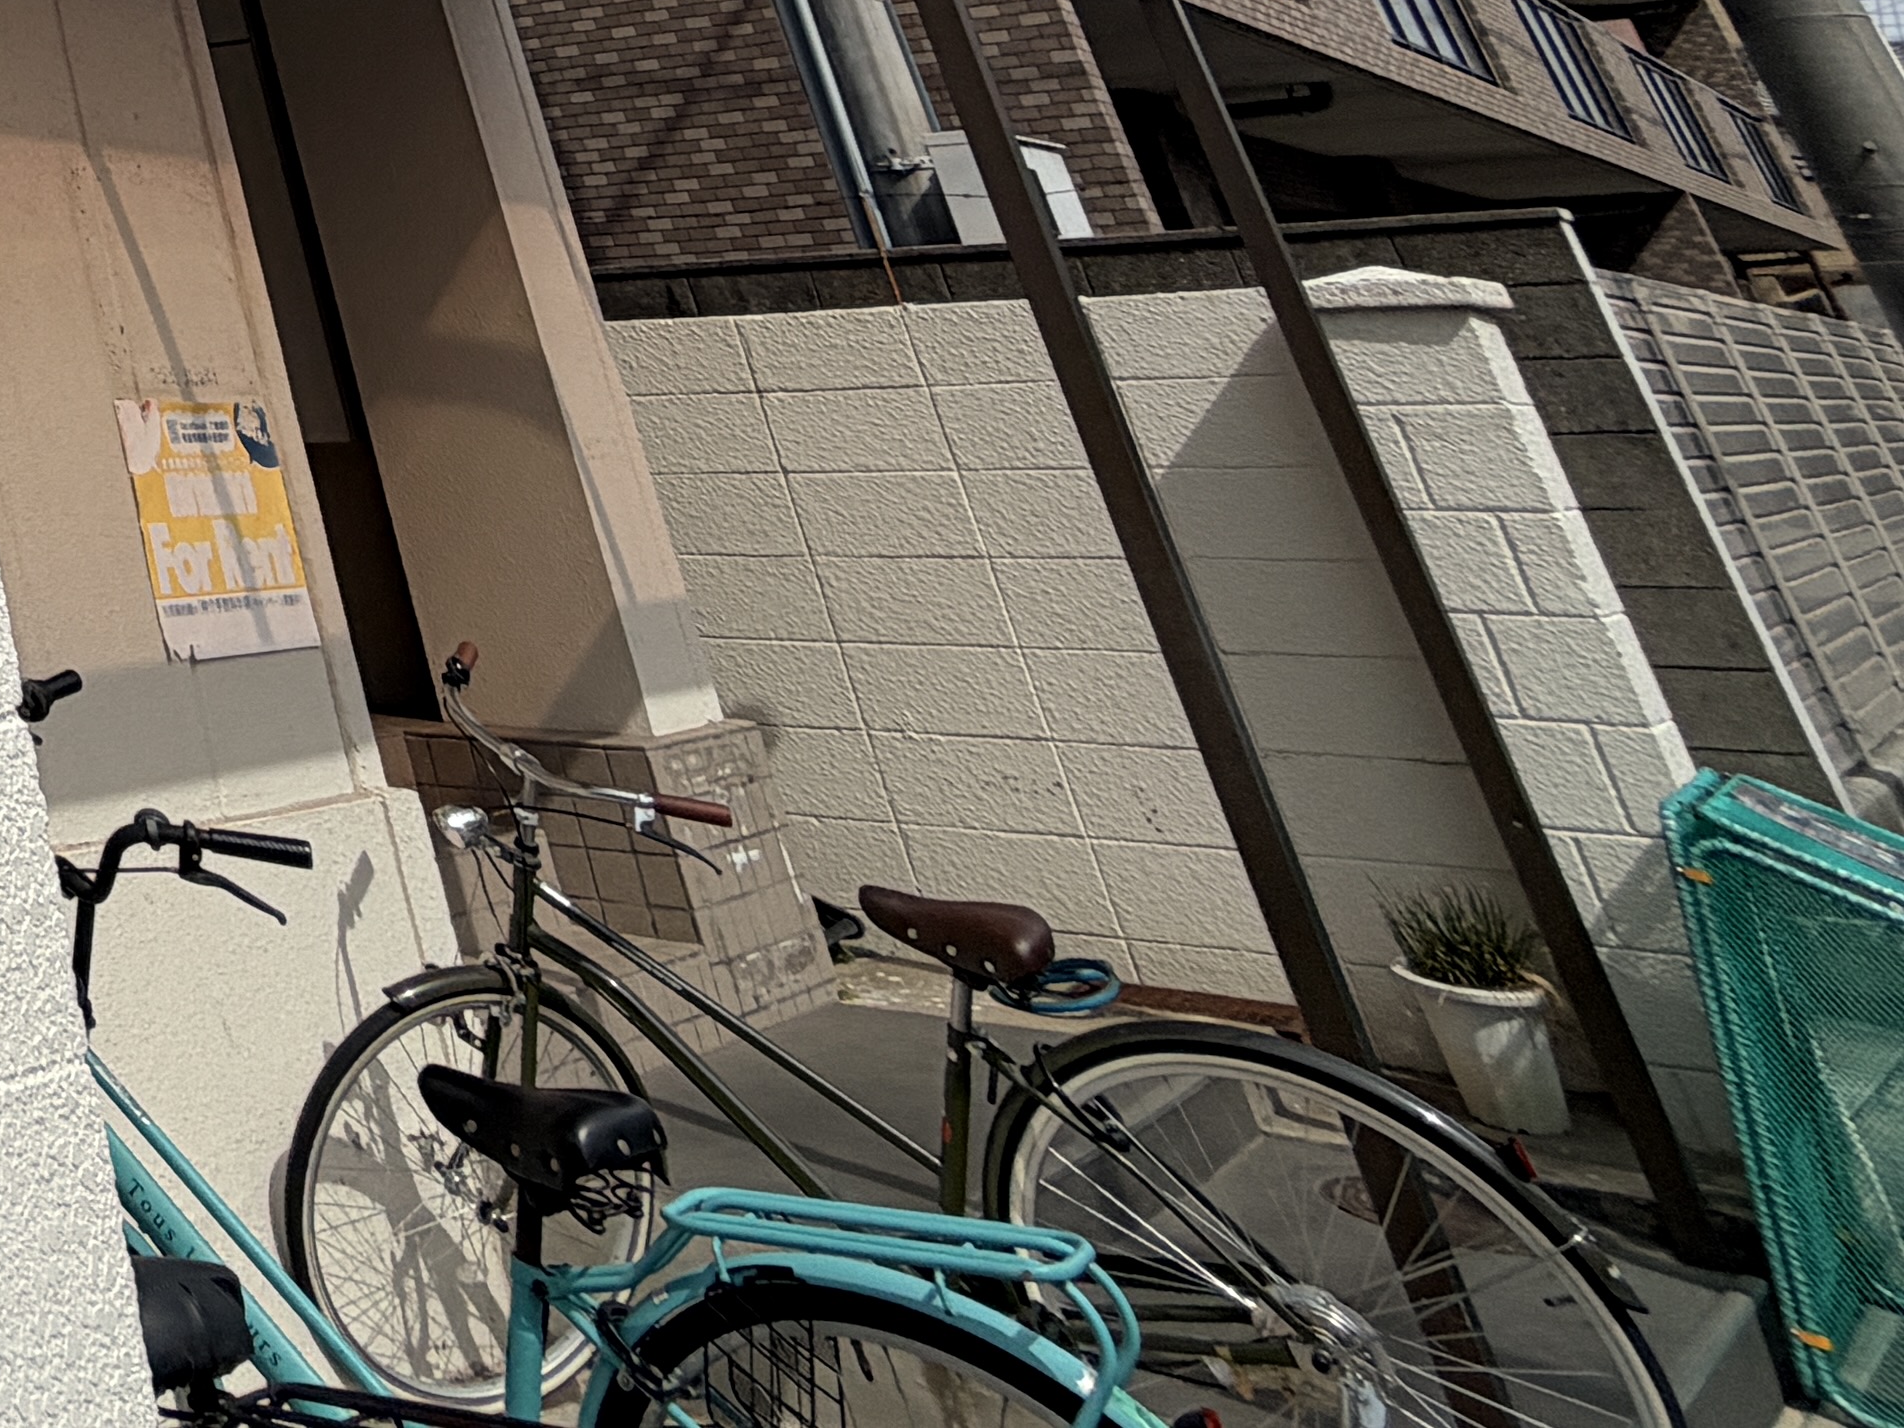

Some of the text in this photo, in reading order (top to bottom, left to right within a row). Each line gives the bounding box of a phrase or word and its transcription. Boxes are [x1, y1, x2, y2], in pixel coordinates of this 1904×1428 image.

[147, 519, 296, 595] For Rent
[127, 1178, 177, 1242] Tous
